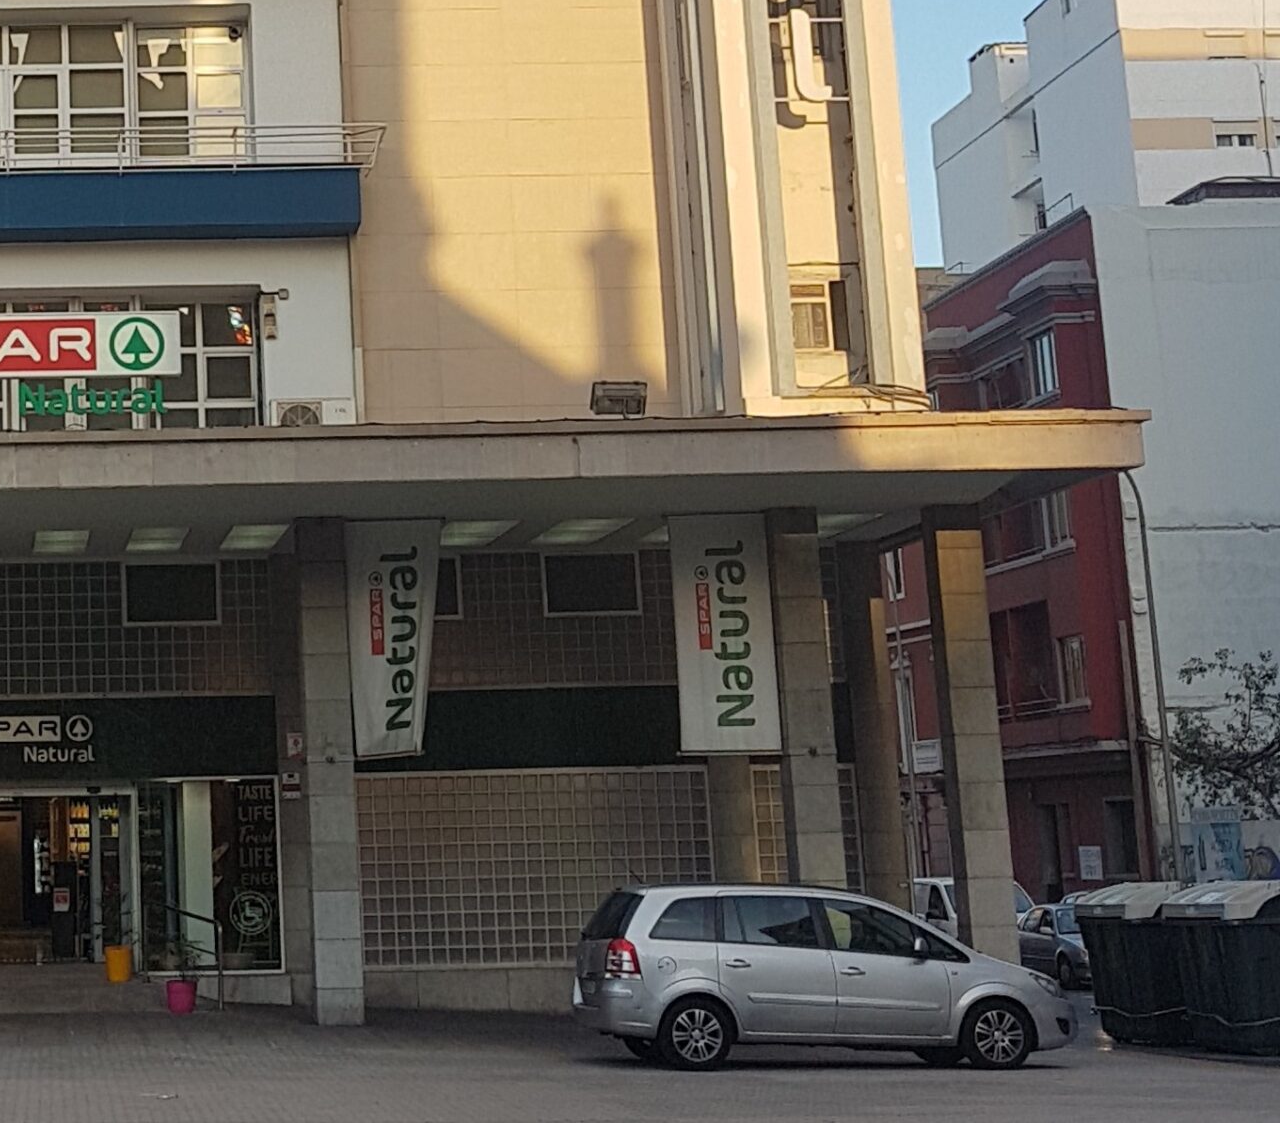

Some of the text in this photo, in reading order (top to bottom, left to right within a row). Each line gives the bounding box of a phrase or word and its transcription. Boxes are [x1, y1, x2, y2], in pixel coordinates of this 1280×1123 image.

[20, 378, 167, 417] Natural
[371, 590, 383, 640] SPAR
[696, 584, 710, 634] SPAR
[379, 545, 418, 731] Natural
[705, 540, 756, 727] Natural
[23, 744, 95, 763] Natural
[237, 785, 272, 800] TASTE
[237, 806, 274, 822] LIFE
[239, 847, 274, 867] LIFE
